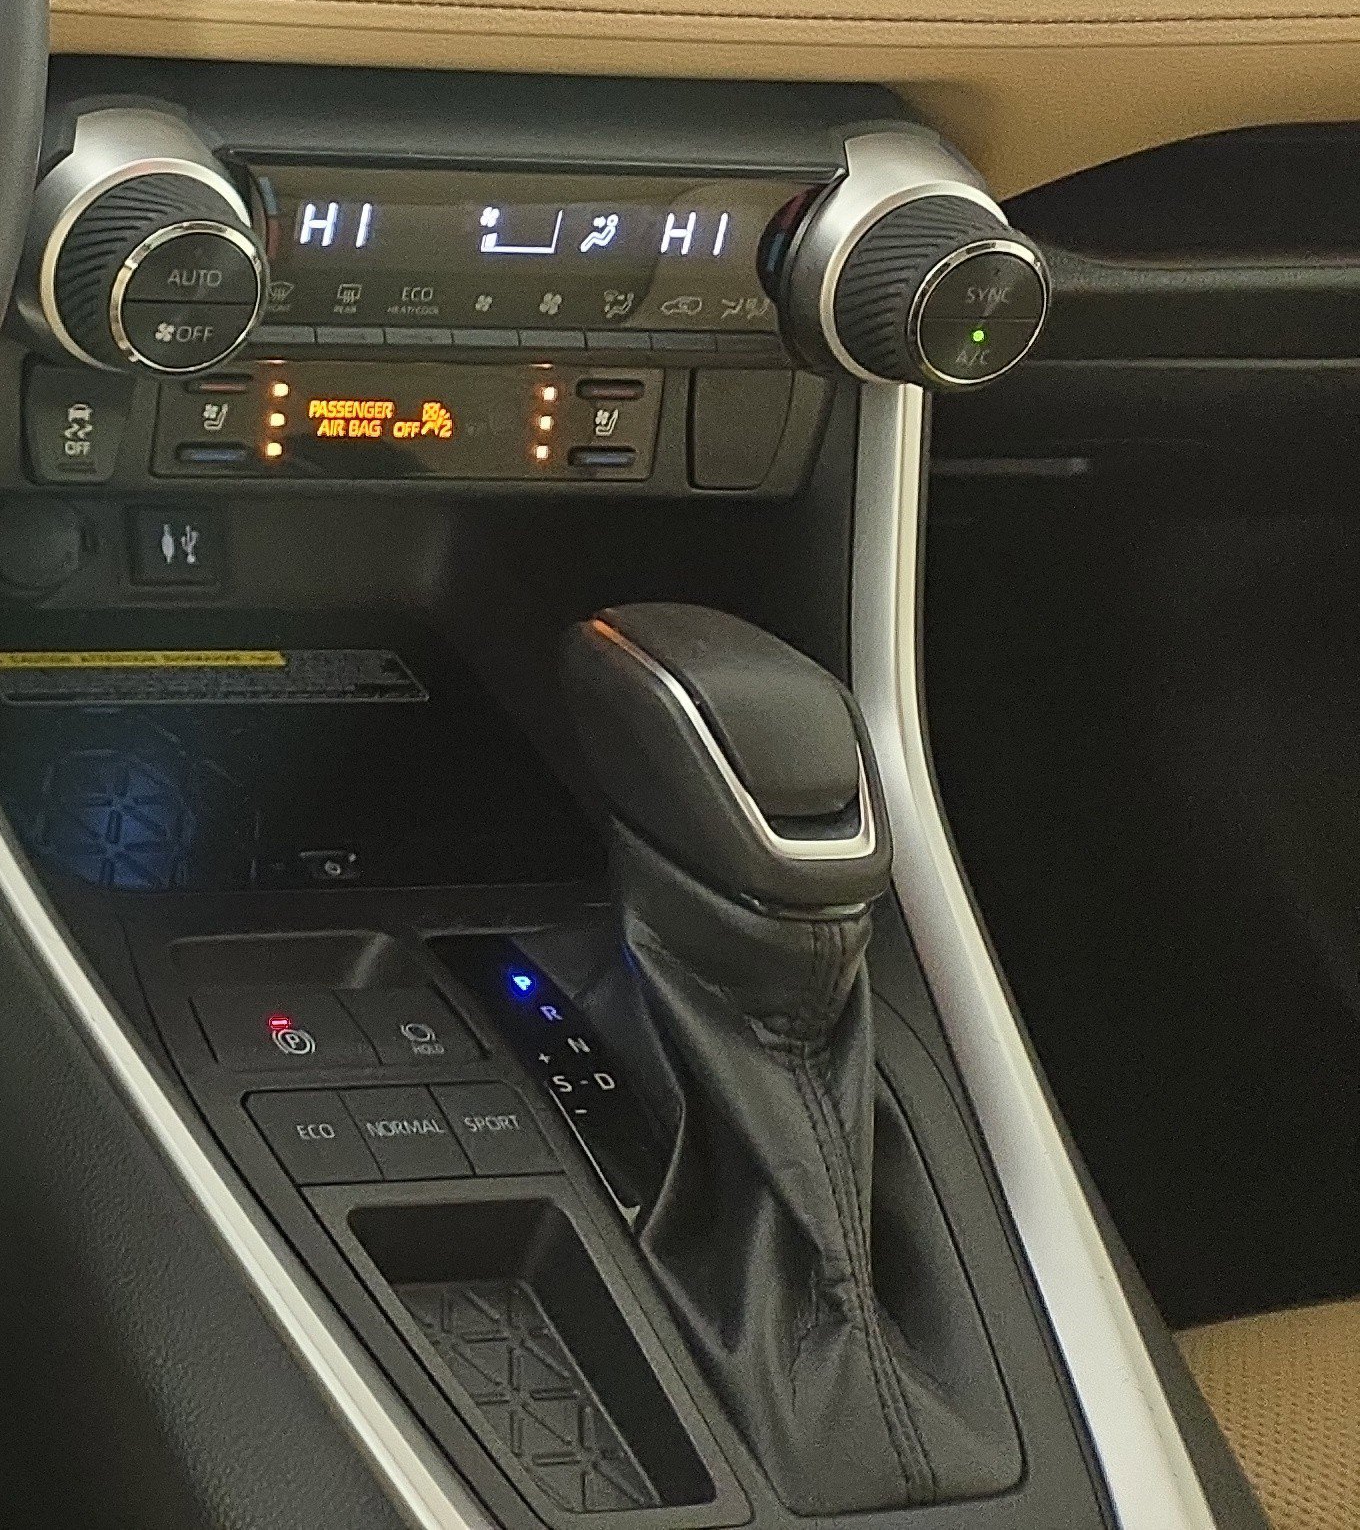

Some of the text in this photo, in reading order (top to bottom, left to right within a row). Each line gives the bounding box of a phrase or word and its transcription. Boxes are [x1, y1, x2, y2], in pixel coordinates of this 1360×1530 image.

[299, 202, 374, 249] HI
[660, 211, 728, 256] HI
[167, 269, 223, 289] AUTO
[401, 286, 433, 302] ECO
[176, 326, 215, 343] OFF
[309, 400, 394, 419] PASSENGER
[317, 419, 421, 438] AIR BAG OFF
[65, 440, 91, 455] OFF
[540, 1006, 563, 1021] R
[594, 1073, 616, 1090] D
[296, 1123, 336, 1140] ECO
[366, 1118, 445, 1137] NORMAL
[463, 1114, 521, 1132] SPORT
